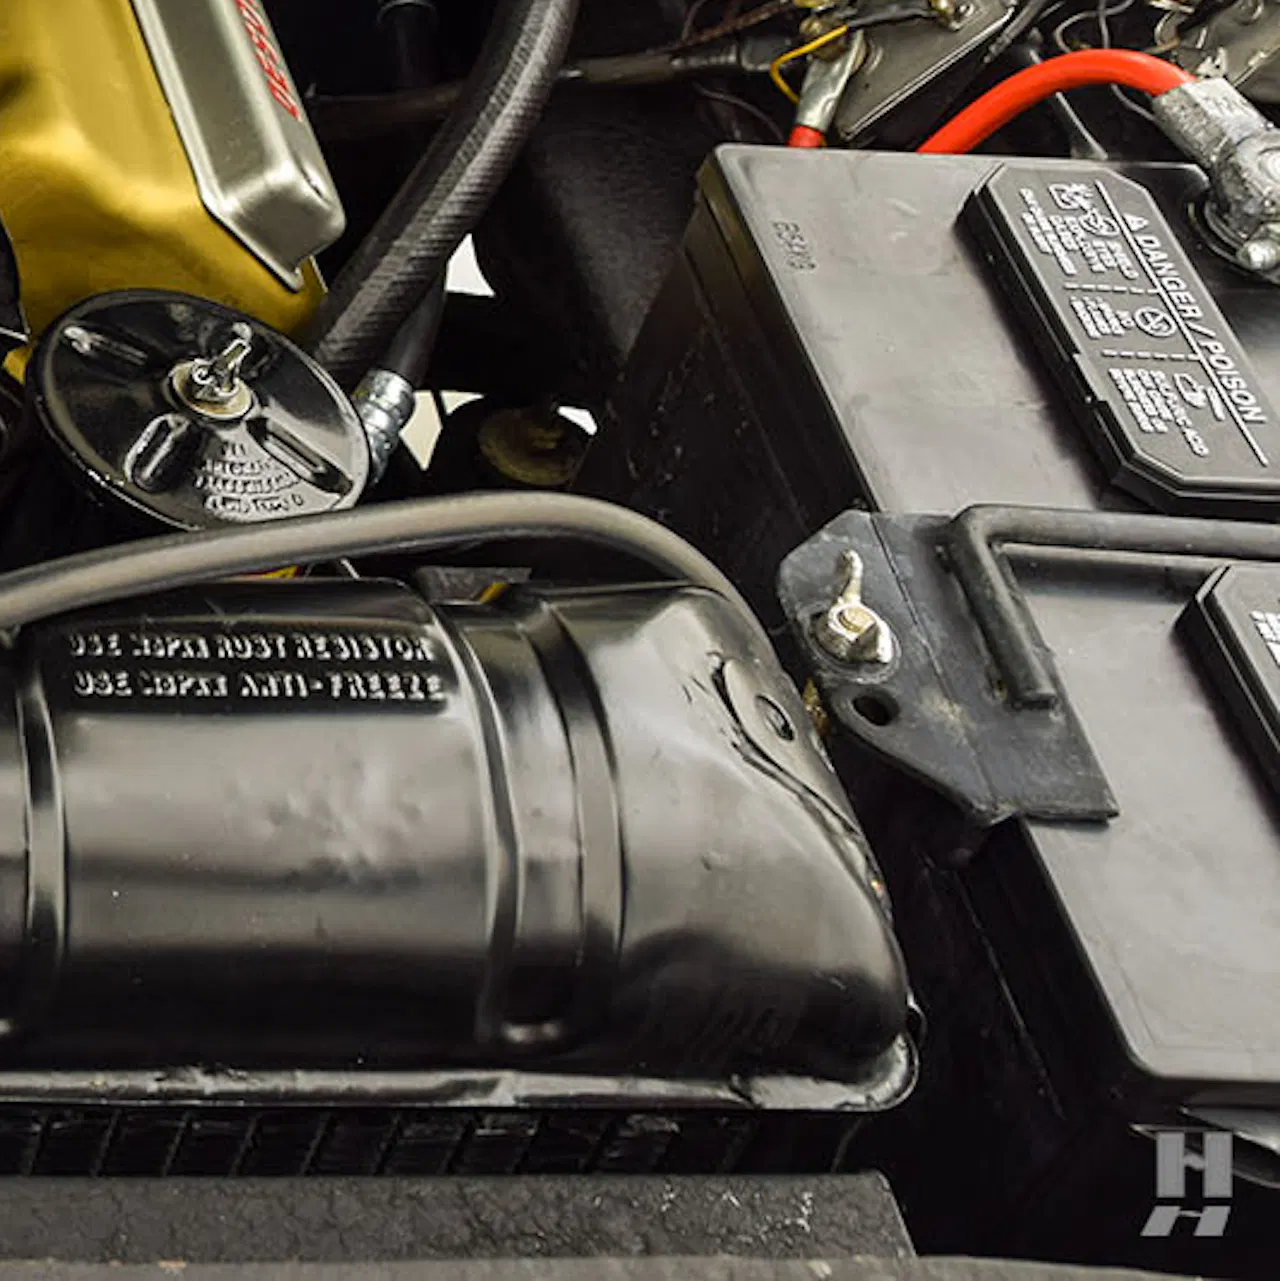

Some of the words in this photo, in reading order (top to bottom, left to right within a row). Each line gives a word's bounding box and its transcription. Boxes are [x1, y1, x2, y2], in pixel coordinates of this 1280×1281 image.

[68, 632, 124, 658] USE
[216, 633, 288, 660] RUST
[73, 670, 133, 697] USE
